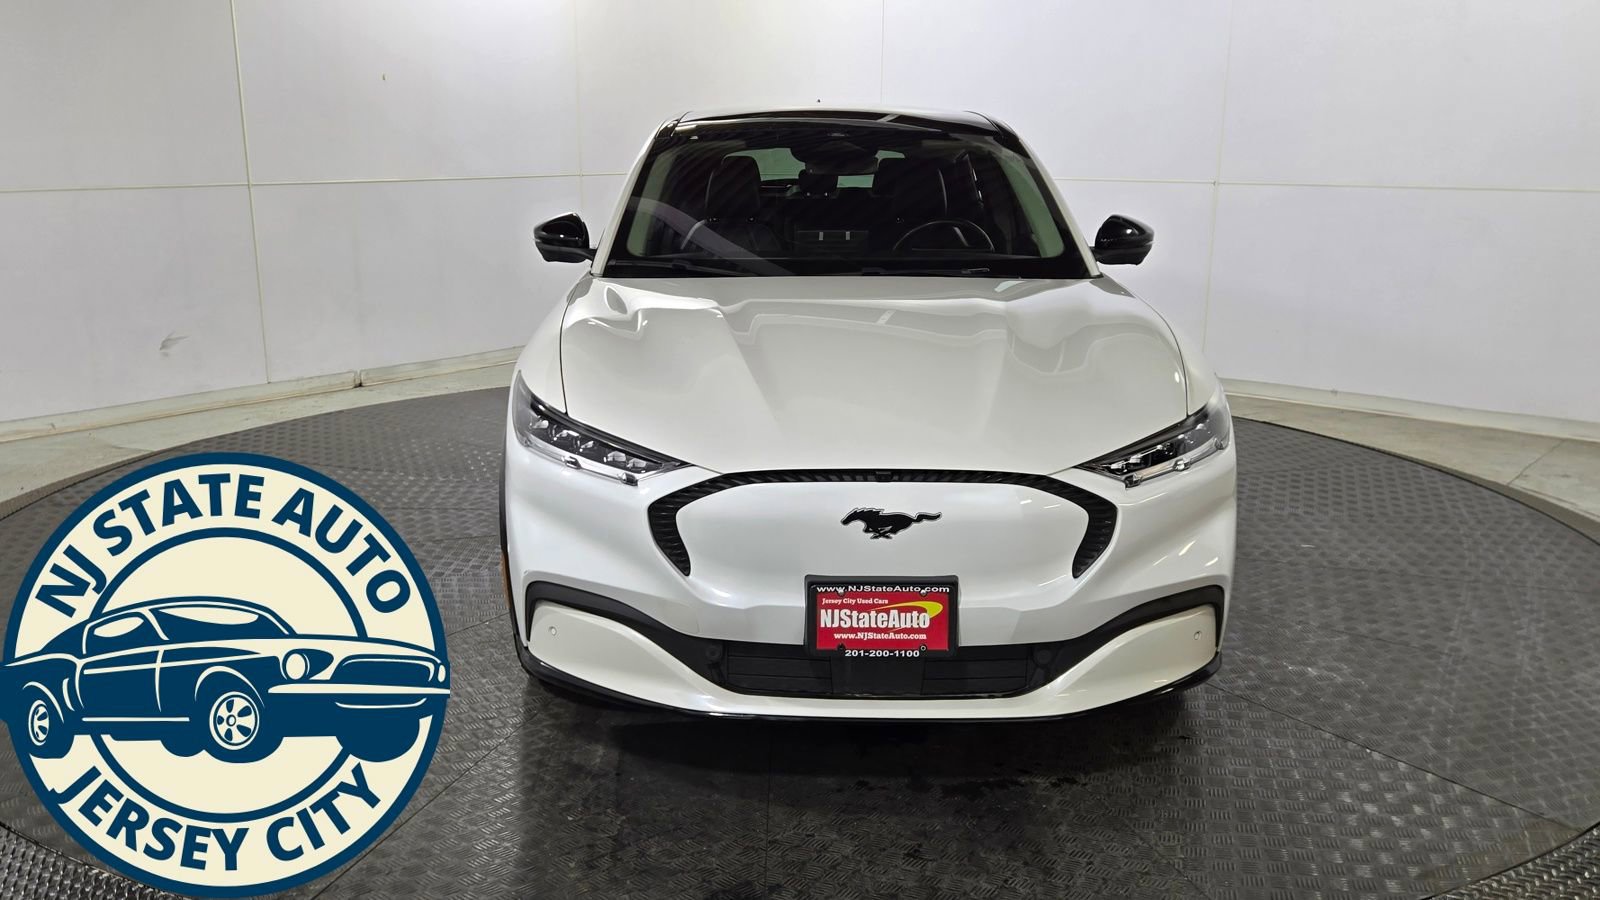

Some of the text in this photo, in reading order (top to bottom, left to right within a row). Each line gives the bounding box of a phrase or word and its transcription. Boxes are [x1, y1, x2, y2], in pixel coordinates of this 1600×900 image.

[820, 609, 930, 629] NJStateAuto
[833, 632, 927, 640] www.NJStateAuto.com
[844, 649, 920, 657] 201-200-1100
